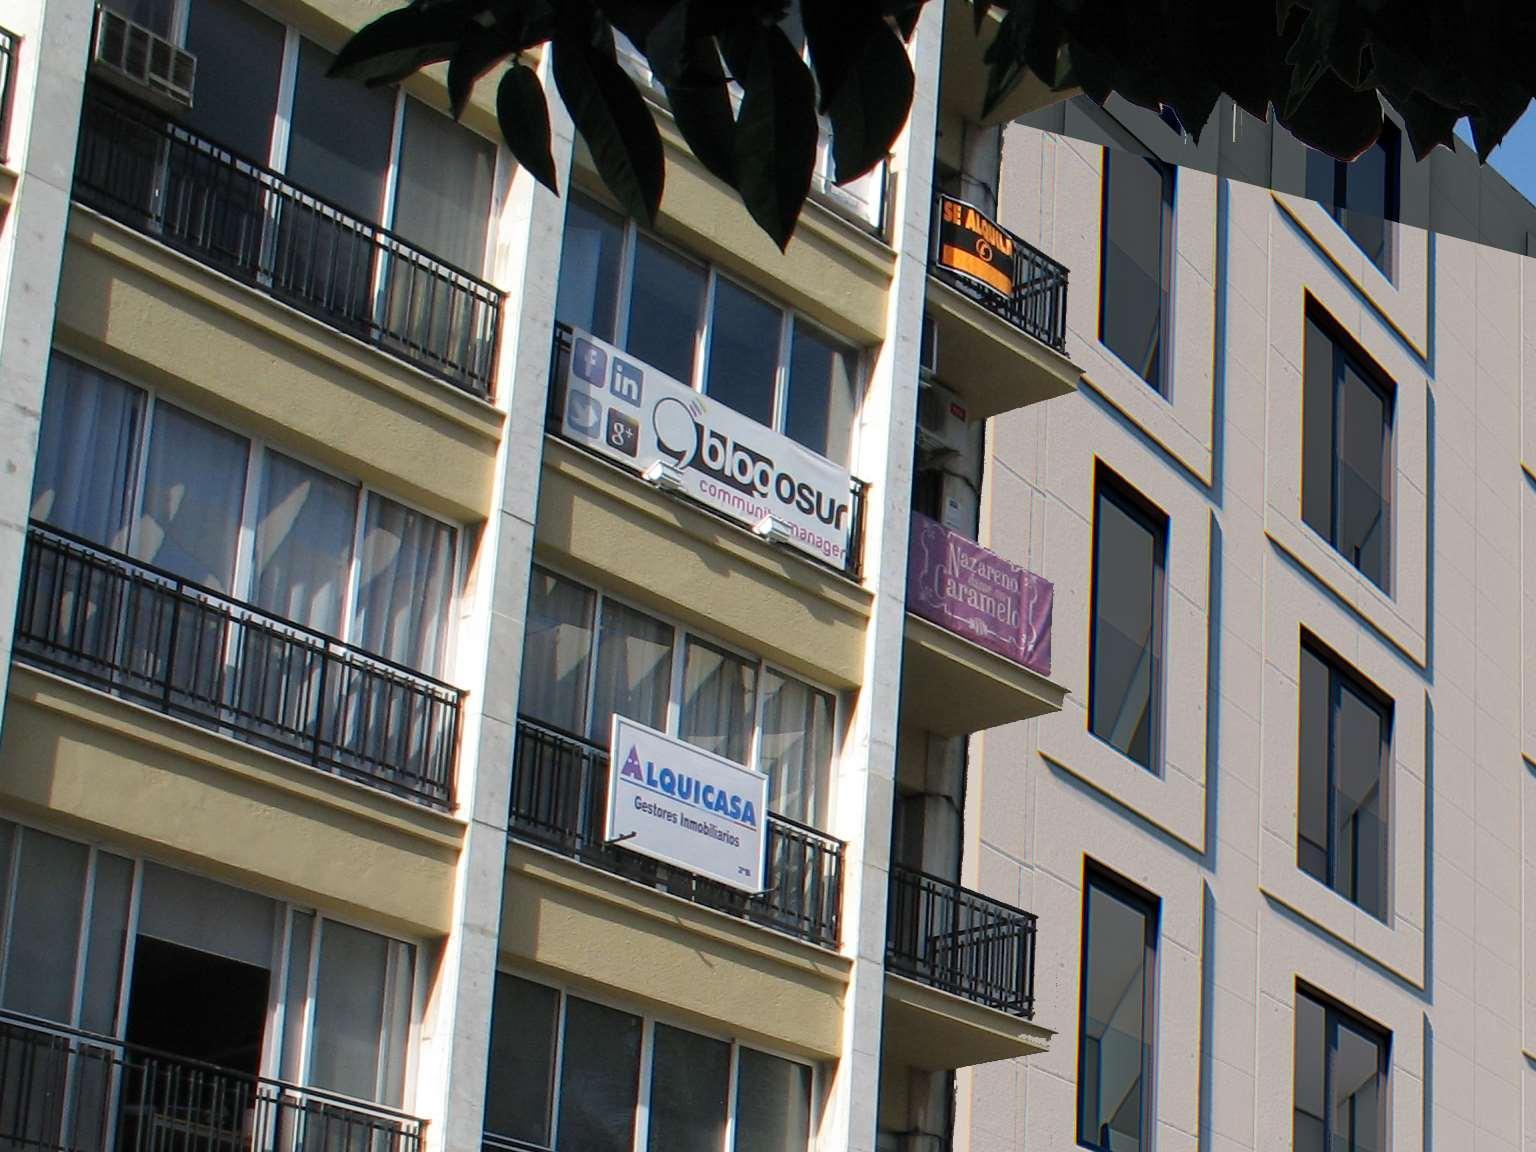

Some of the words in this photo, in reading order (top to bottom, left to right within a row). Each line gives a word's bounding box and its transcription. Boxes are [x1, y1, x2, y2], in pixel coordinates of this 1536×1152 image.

[943, 200, 962, 226] SE
[613, 367, 640, 401] in
[701, 425, 849, 531] blogosur
[944, 543, 1019, 593] Nazareno
[934, 563, 1020, 629] Caramelo
[620, 744, 758, 827] ALQUICASA
[633, 795, 678, 824] Gestores
[680, 812, 741, 848] Inmobiliarios
